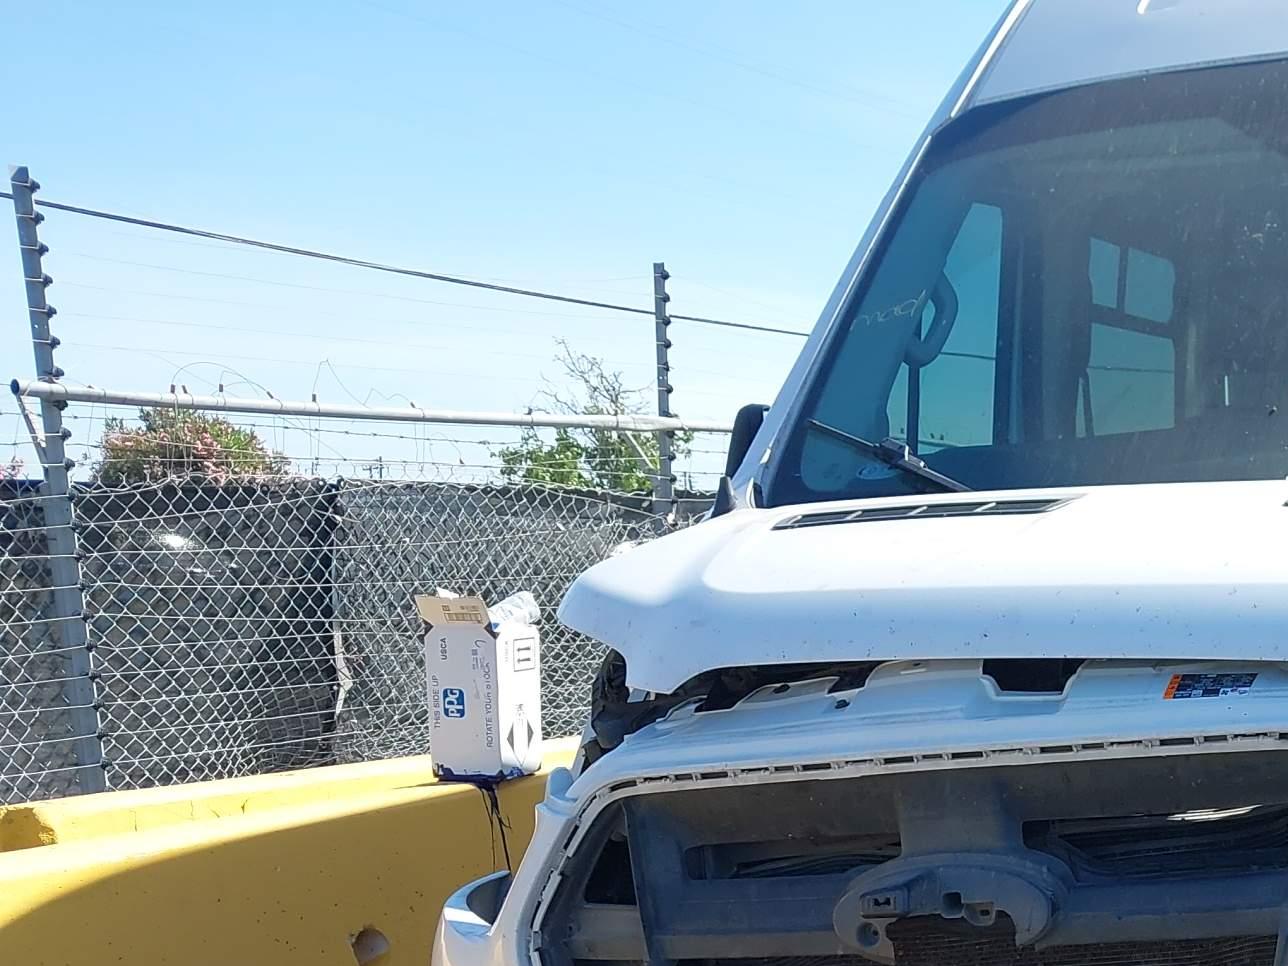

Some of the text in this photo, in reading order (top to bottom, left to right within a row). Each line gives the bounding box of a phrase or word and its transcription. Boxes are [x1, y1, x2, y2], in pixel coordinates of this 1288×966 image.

[439, 637, 448, 660] USCA
[431, 674, 441, 729] THIS SIDE UP
[444, 688, 464, 718] PPG
[485, 717, 494, 748] ROTATE
